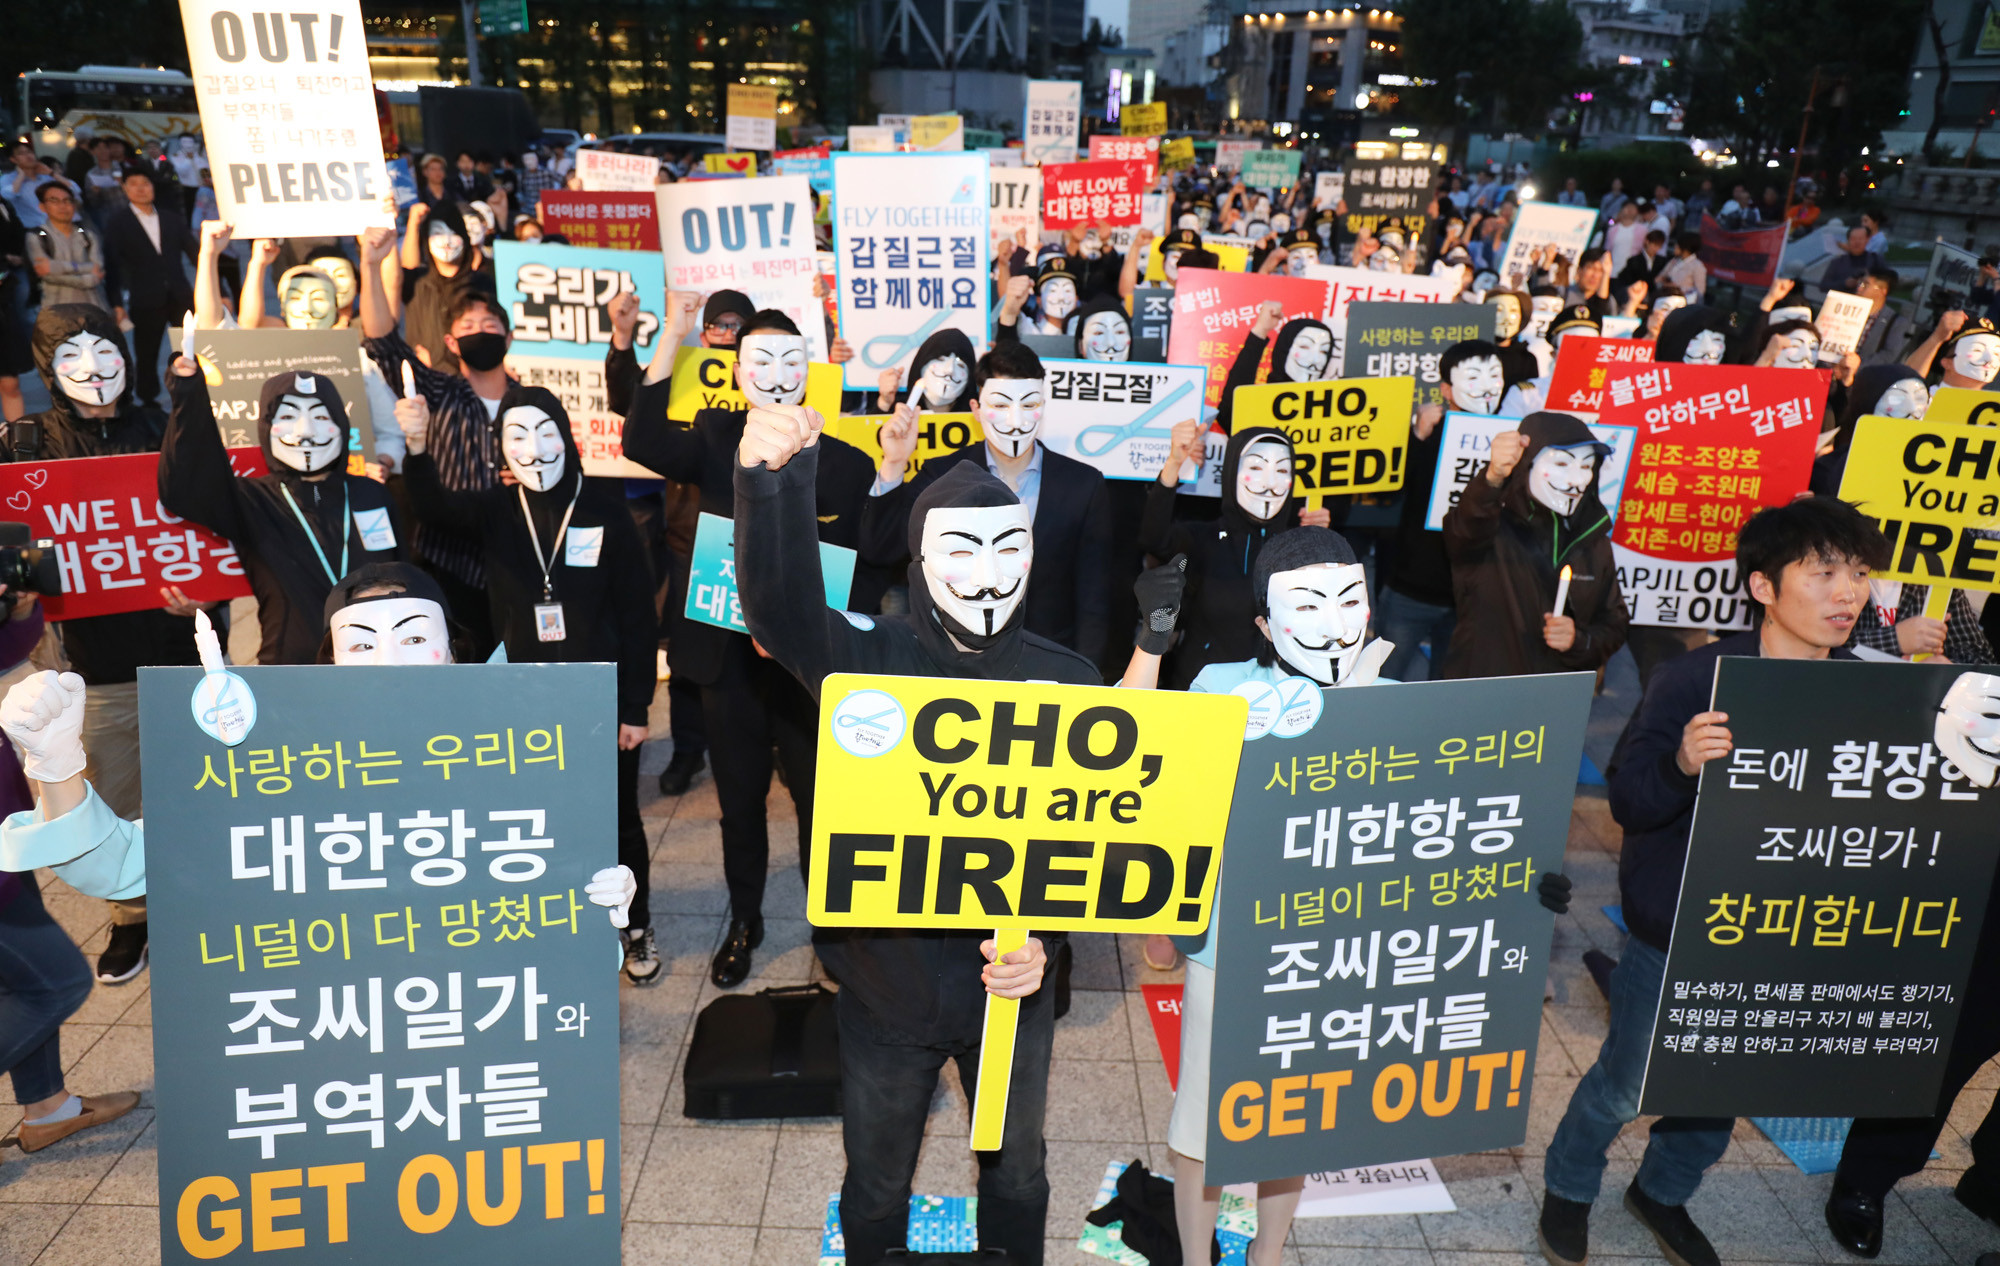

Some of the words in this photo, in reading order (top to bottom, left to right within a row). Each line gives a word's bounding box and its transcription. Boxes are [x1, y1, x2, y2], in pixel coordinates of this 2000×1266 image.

[211, 11, 344, 63] OUT!
[1098, 141, 1147, 160] 조양호
[229, 162, 376, 204] PLEASE
[990, 183, 1029, 208] UT!
[1057, 180, 1082, 195] WE
[1087, 177, 1128, 194] LOVE
[682, 202, 795, 255] OUT!
[844, 207, 878, 227] FLY
[885, 206, 983, 228] TOGETHER
[1047, 194, 1140, 221] 대한항공!
[850, 236, 976, 268] 갑질근절
[517, 264, 635, 306] 우리가
[851, 277, 977, 309] 함께해요
[1180, 287, 1221, 313] 불법!
[512, 302, 659, 347] 노비?
[1834, 303, 1863, 317] OUT!
[1359, 326, 1425, 347] 사랑하는
[1430, 325, 1479, 345] 우리의
[1272, 387, 1378, 422] CHO,
[1609, 368, 1673, 407] 불법!
[1645, 385, 1751, 434] 안하무인
[1750, 397, 1814, 437] 갑질!
[1329, 424, 1370, 442] are
[1294, 447, 1402, 489] RED!
[1639, 442, 1761, 470] 원조-조양호
[1634, 471, 1679, 496] 세습
[1903, 480, 1967, 514] You
[43, 499, 120, 535] WE
[541, 631, 564, 641] OUT
[194, 740, 403, 798] 사랑하는
[423, 724, 566, 781] 우리의
[912, 697, 1164, 788] CHO,
[1264, 745, 1420, 795] 사랑하는
[1434, 725, 1545, 775] 우리의
[1727, 747, 1808, 791] 돈에
[918, 772, 1027, 820] You
[1046, 787, 1142, 824] are
[229, 809, 555, 894] 대한항공
[1283, 795, 1523, 869] 대한항공
[1756, 825, 1918, 868] 조씨일가
[825, 832, 1213, 923] FIRED!
[1254, 882, 1363, 930] 니덜이
[1379, 875, 1415, 911] 다
[1429, 857, 1536, 905] 망쳤다
[199, 912, 352, 972] 니덜이
[374, 906, 422, 954] 다
[440, 888, 584, 948] 망쳤다
[1704, 893, 1961, 949] 창피합니다
[1263, 919, 1500, 993] 조씨일가
[1501, 945, 1529, 973] 와
[225, 967, 548, 1057] 조씨일가
[554, 1001, 590, 1038] 와
[1673, 981, 1748, 1002] 밀수하기,
[1754, 982, 1805, 1001] 면세품
[1810, 983, 1895, 1002] 판매에서도
[1901, 984, 1955, 1004] 챙기기,
[1259, 992, 1491, 1069] 부역자들
[1668, 1008, 1738, 1028] 직원임금
[1743, 1010, 1812, 1028] 안올리구
[1817, 1010, 1851, 1028] 자기
[1857, 1010, 1872, 1028] 배
[1879, 1010, 1933, 1030] 불리기,
[1663, 1034, 1698, 1053] 직원
[1703, 1035, 1738, 1053] 충원
[1743, 1036, 1794, 1053] 안하고
[1799, 1036, 1867, 1055] 기계처럼
[1872, 1037, 1939, 1055] 부려먹기
[227, 1061, 549, 1160] 부역자들
[1218, 1070, 1353, 1143] GET
[1371, 1049, 1526, 1123] OUT!
[1355, 1166, 1430, 1184] 싶습니다
[176, 1161, 366, 1260] GET
[397, 1138, 606, 1235] OUT!
